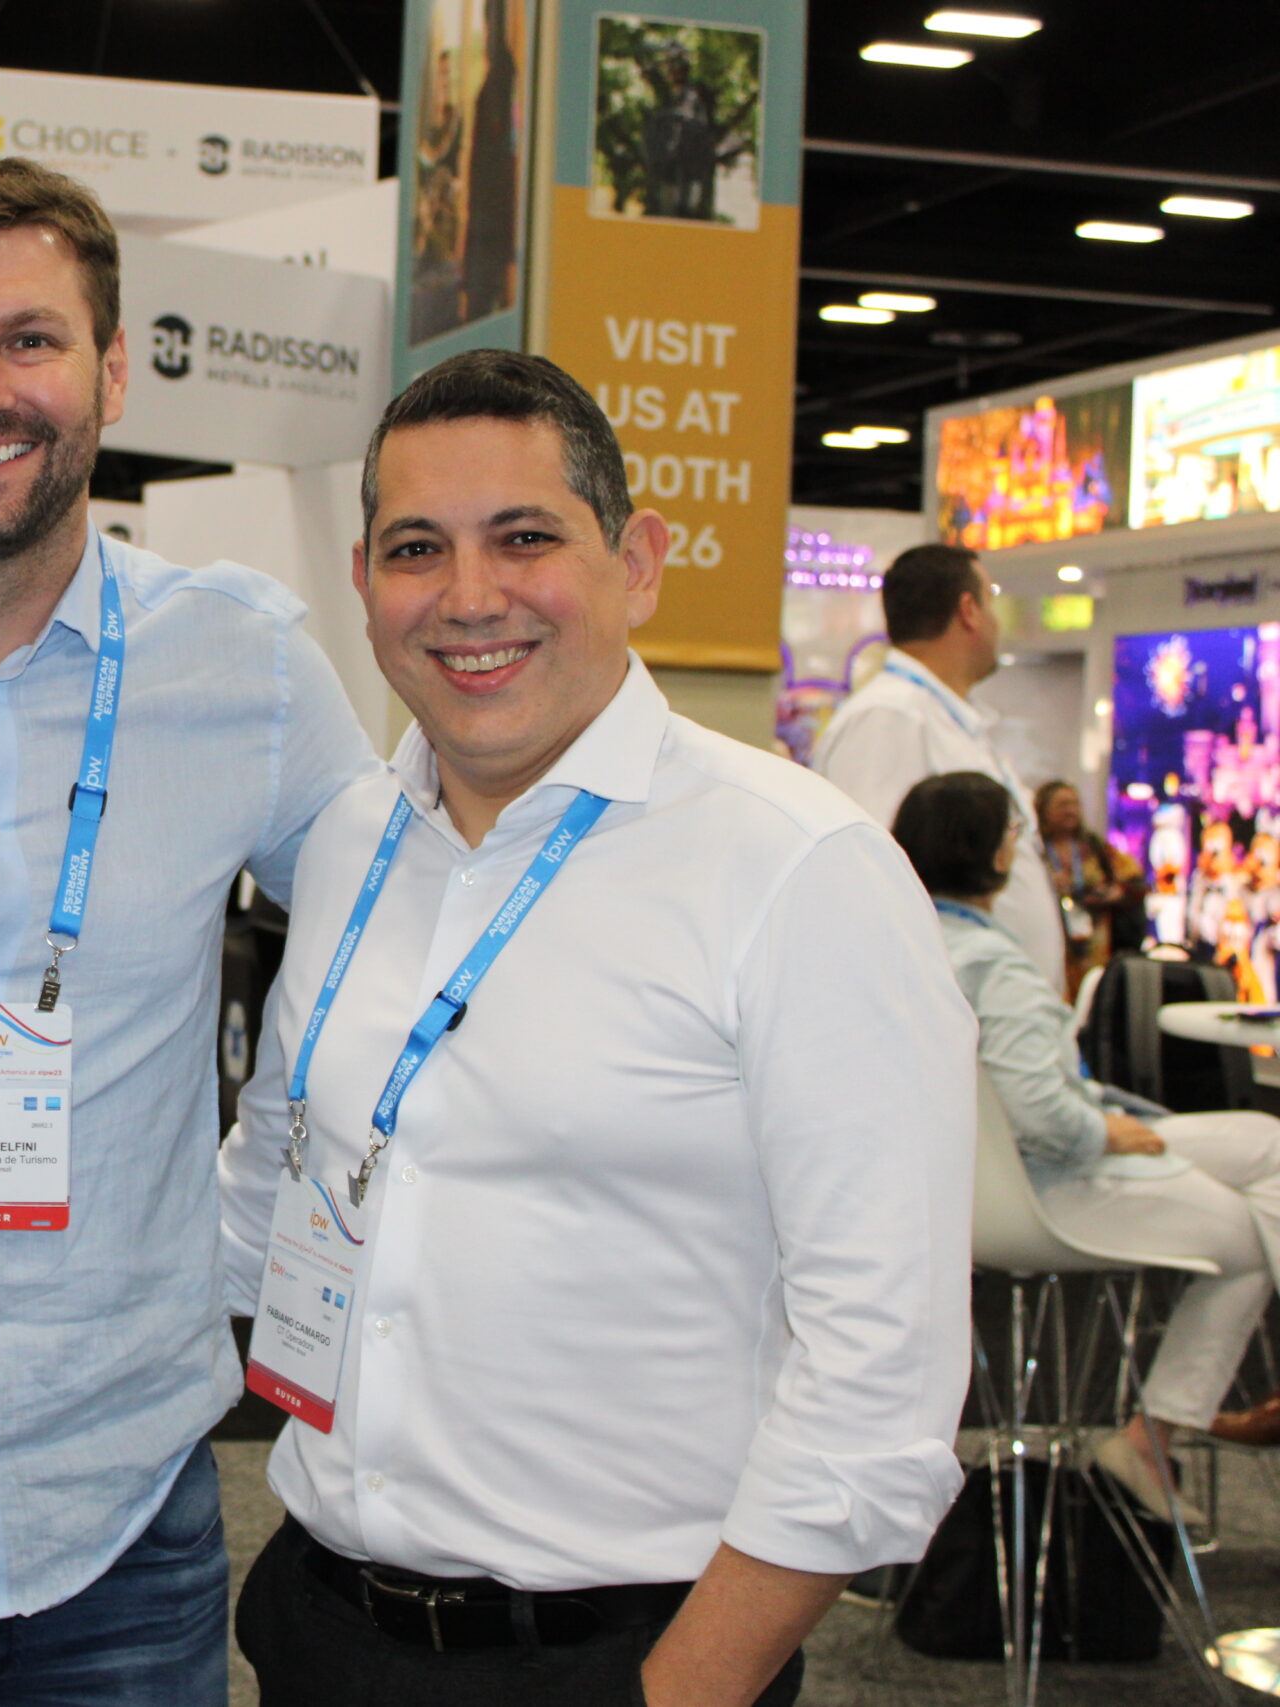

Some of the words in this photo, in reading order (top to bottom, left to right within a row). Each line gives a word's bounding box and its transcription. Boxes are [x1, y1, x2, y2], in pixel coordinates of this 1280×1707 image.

[12, 120, 150, 158] CHOICE
[242, 138, 365, 168] RADISSON
[207, 325, 360, 375] RADISSON
[604, 316, 736, 368] VISIT
[596, 383, 667, 430] US
[675, 389, 741, 435] AT
[621, 452, 751, 503] OOTH
[665, 521, 724, 569] 26
[101, 609, 123, 641] ipw
[93, 656, 110, 721] AMERICAN
[103, 659, 119, 716] EXPRESS
[80, 755, 104, 791] ipw
[540, 828, 575, 864] ipw
[62, 854, 79, 914] EXPRESS
[71, 848, 90, 916] AMERICAN
[367, 857, 388, 892] ipw
[488, 874, 534, 938] AMERICAN
[498, 880, 541, 935] EXPRESS
[442, 967, 475, 1005] ipw
[307, 1007, 326, 1042] ipw
[5, 1155, 17, 1164] de
[20, 1155, 58, 1164] Turismo
[310, 1207, 329, 1230] ipw
[266, 1305, 294, 1328] FABIANO
[295, 1321, 331, 1347] CAMARGO
[285, 1330, 315, 1353] Operadora
[274, 1387, 302, 1408] BUYER
